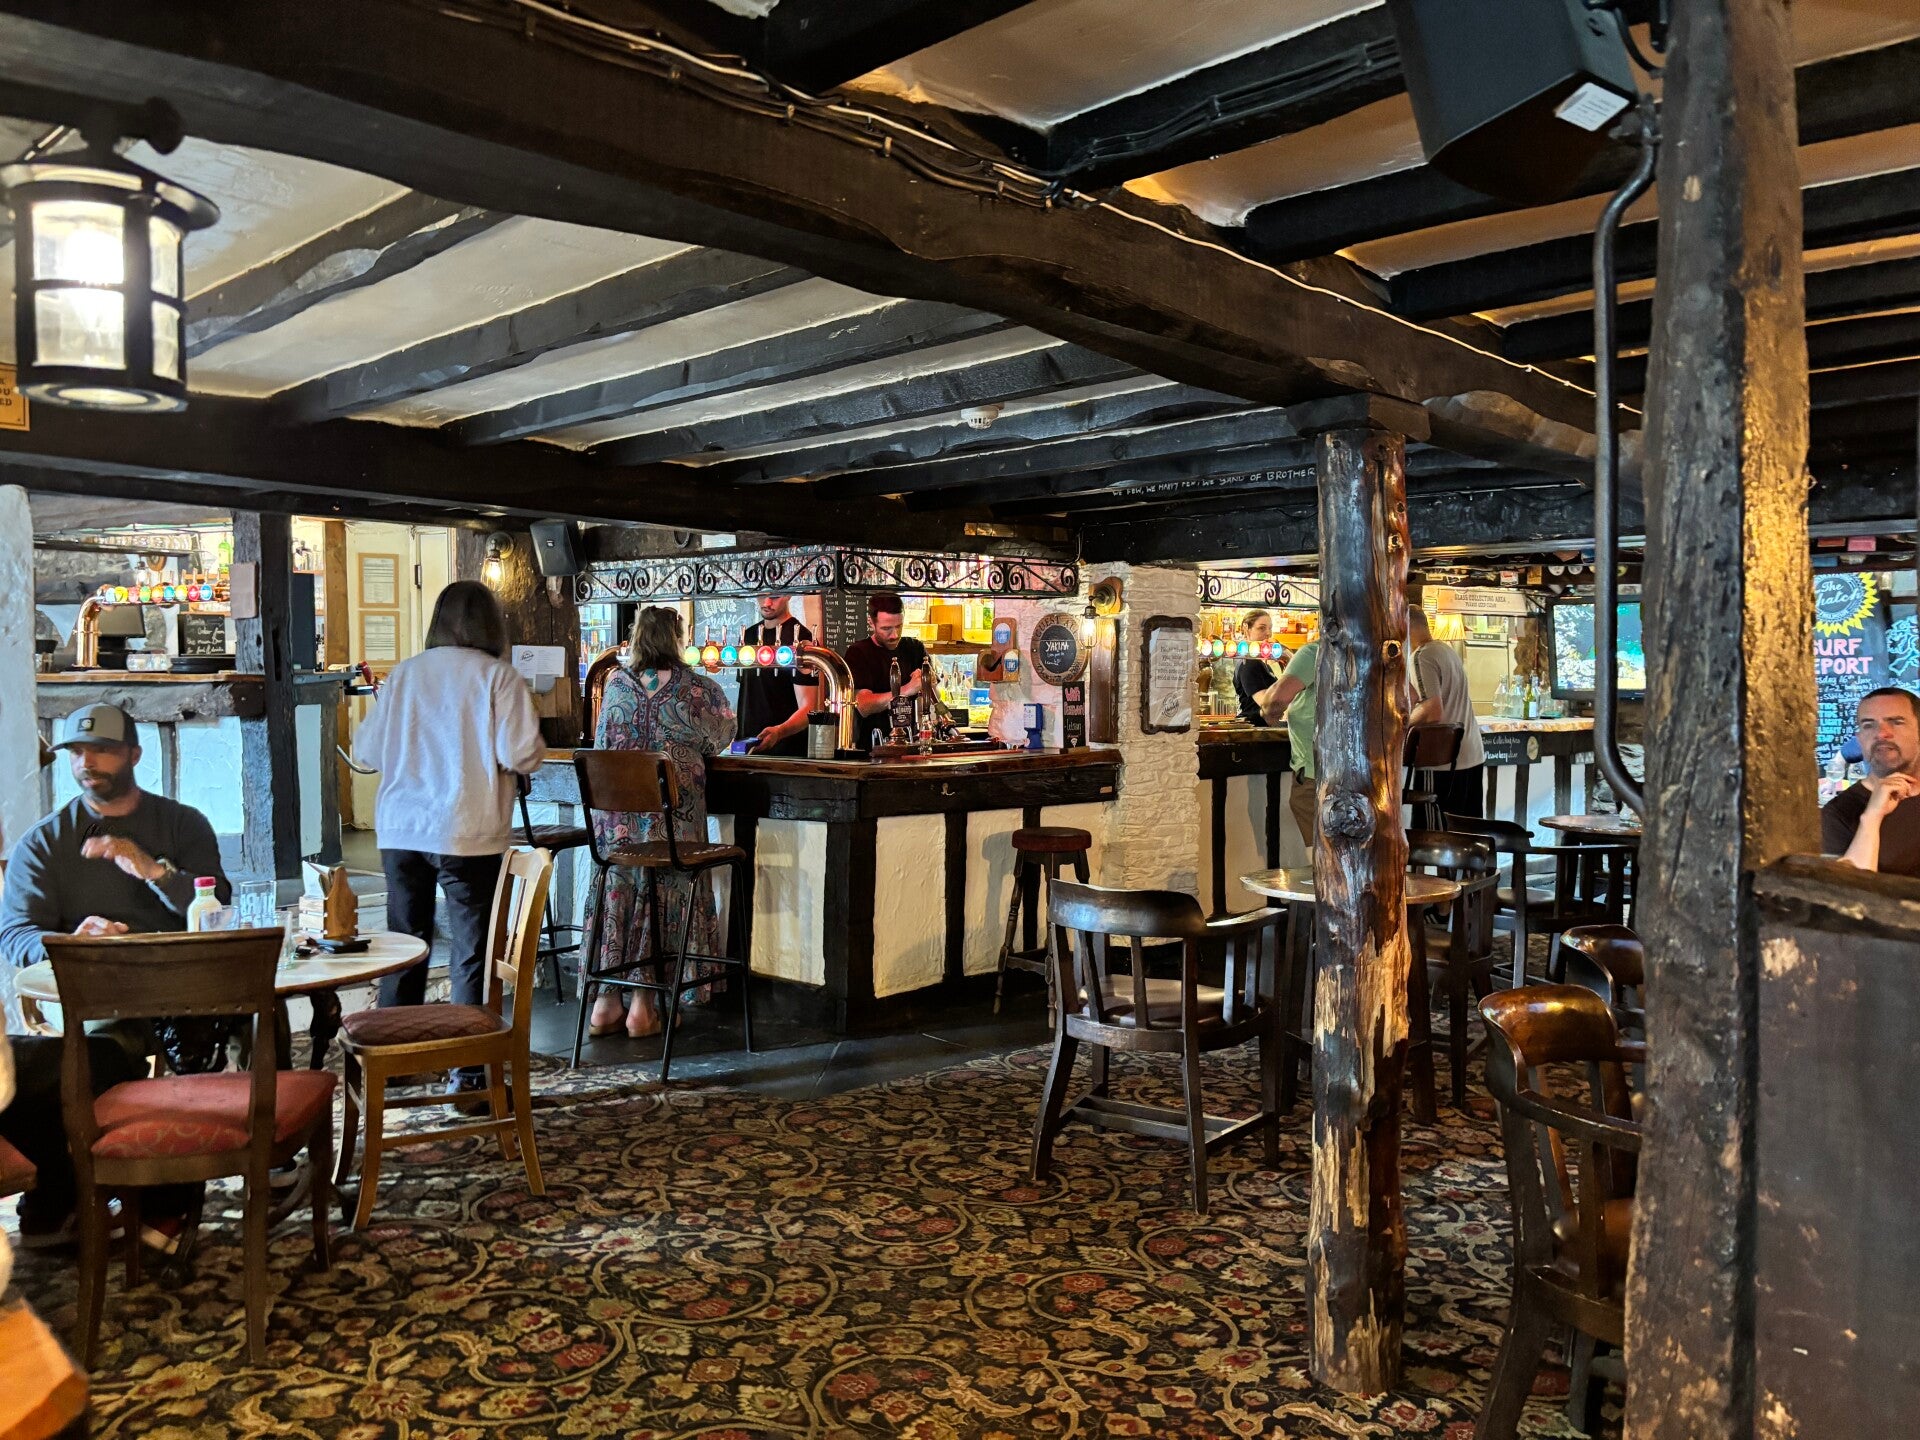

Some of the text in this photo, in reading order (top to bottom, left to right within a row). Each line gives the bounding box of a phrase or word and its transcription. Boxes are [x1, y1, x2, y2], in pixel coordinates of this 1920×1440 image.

[1250, 473, 1261, 481] OF
[1821, 580, 1844, 592] The
[1814, 657, 1873, 675] EPORT
